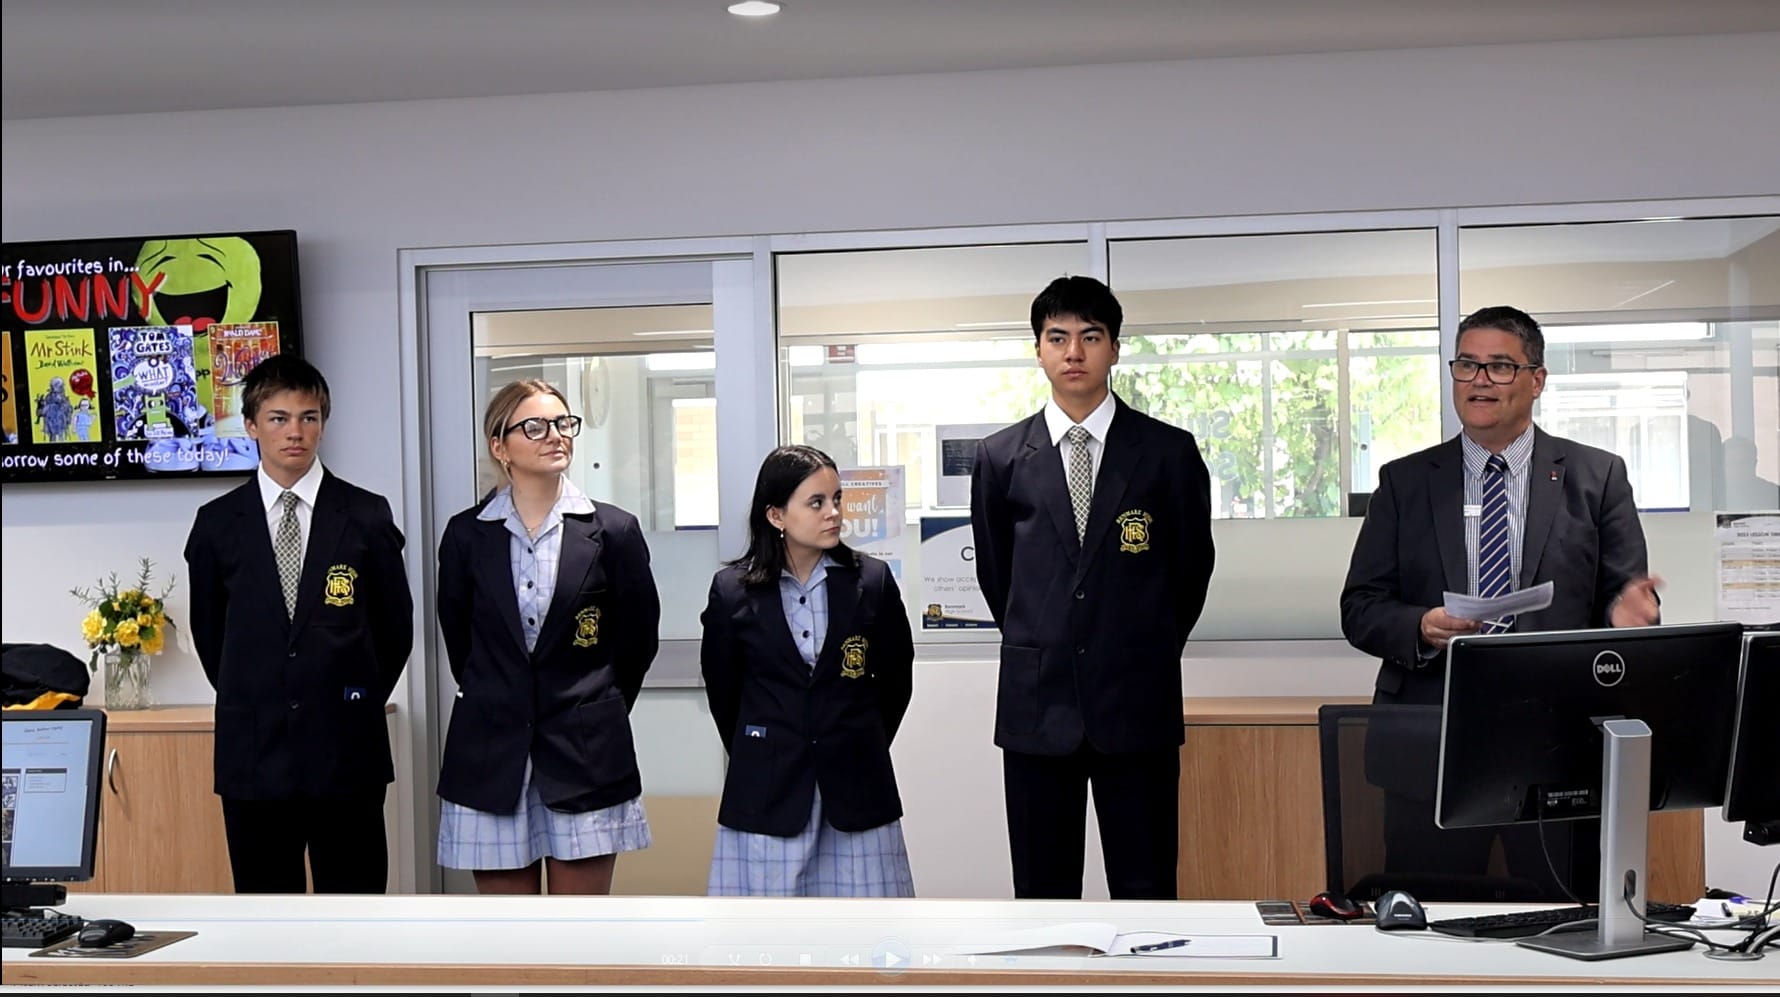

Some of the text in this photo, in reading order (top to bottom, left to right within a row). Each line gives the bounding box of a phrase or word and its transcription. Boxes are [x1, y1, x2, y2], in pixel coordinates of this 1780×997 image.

[17, 258, 104, 280] favourites
[108, 256, 140, 273] in...
[140, 332, 166, 341] TOM
[30, 338, 93, 358] Mr Stink
[136, 342, 171, 353] GATES
[139, 366, 169, 380] WHAT
[54, 451, 99, 467] some
[103, 447, 121, 468] of
[126, 447, 170, 465] these
[177, 447, 230, 468] today!
[846, 494, 878, 515] want
[839, 517, 879, 538] OU!
[960, 546, 975, 562] C
[1596, 663, 1622, 674] DELL
